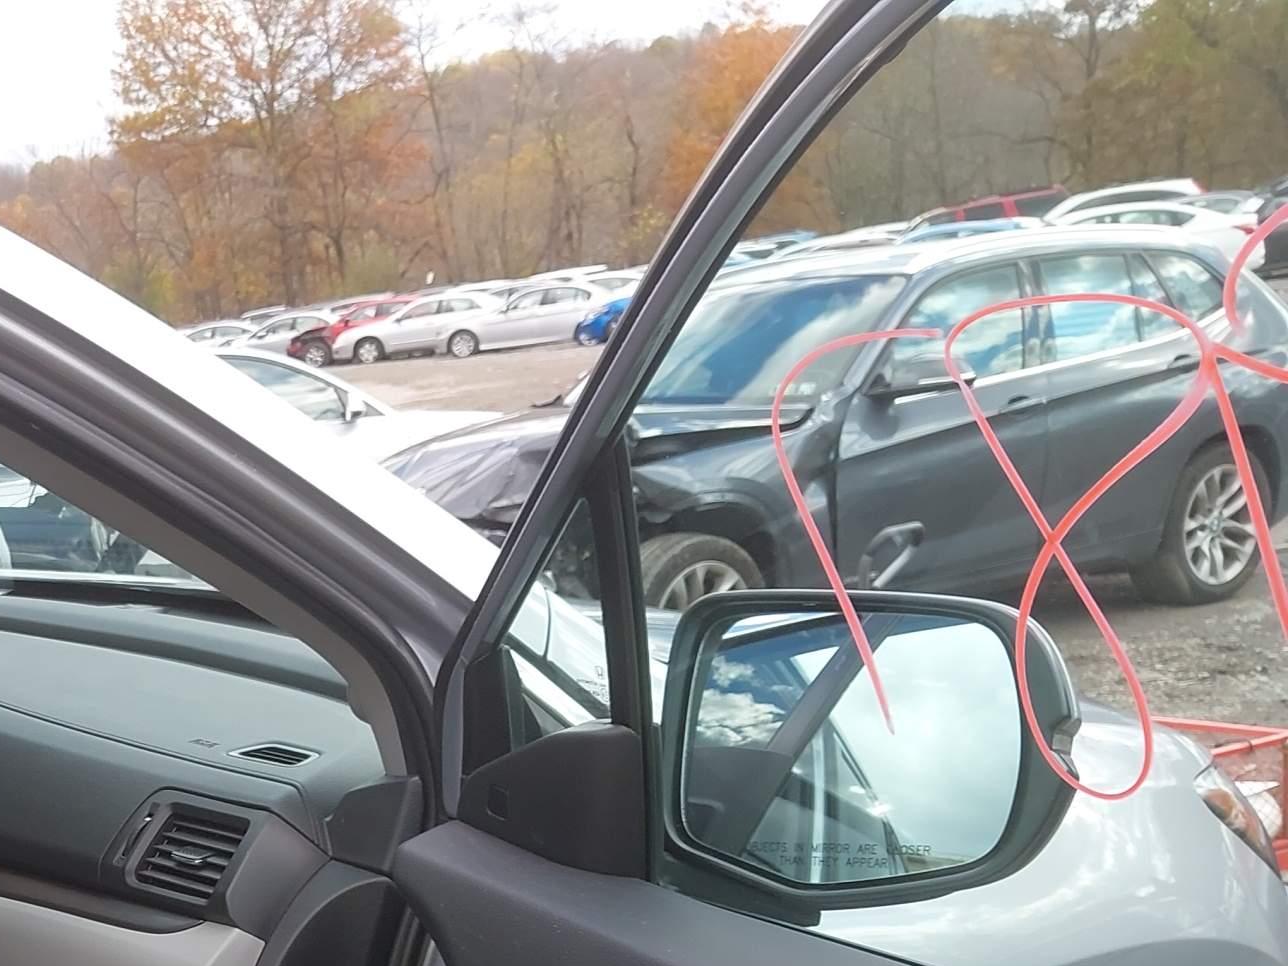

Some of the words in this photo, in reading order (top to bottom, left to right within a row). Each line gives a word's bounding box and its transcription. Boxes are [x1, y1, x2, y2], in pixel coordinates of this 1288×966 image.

[746, 840, 788, 853] BJECTS
[811, 842, 850, 855] MIRROR
[857, 843, 879, 856] ARE
[779, 855, 804, 866] THAN
[813, 856, 839, 868] THEY
[846, 857, 888, 869] APPEAR
